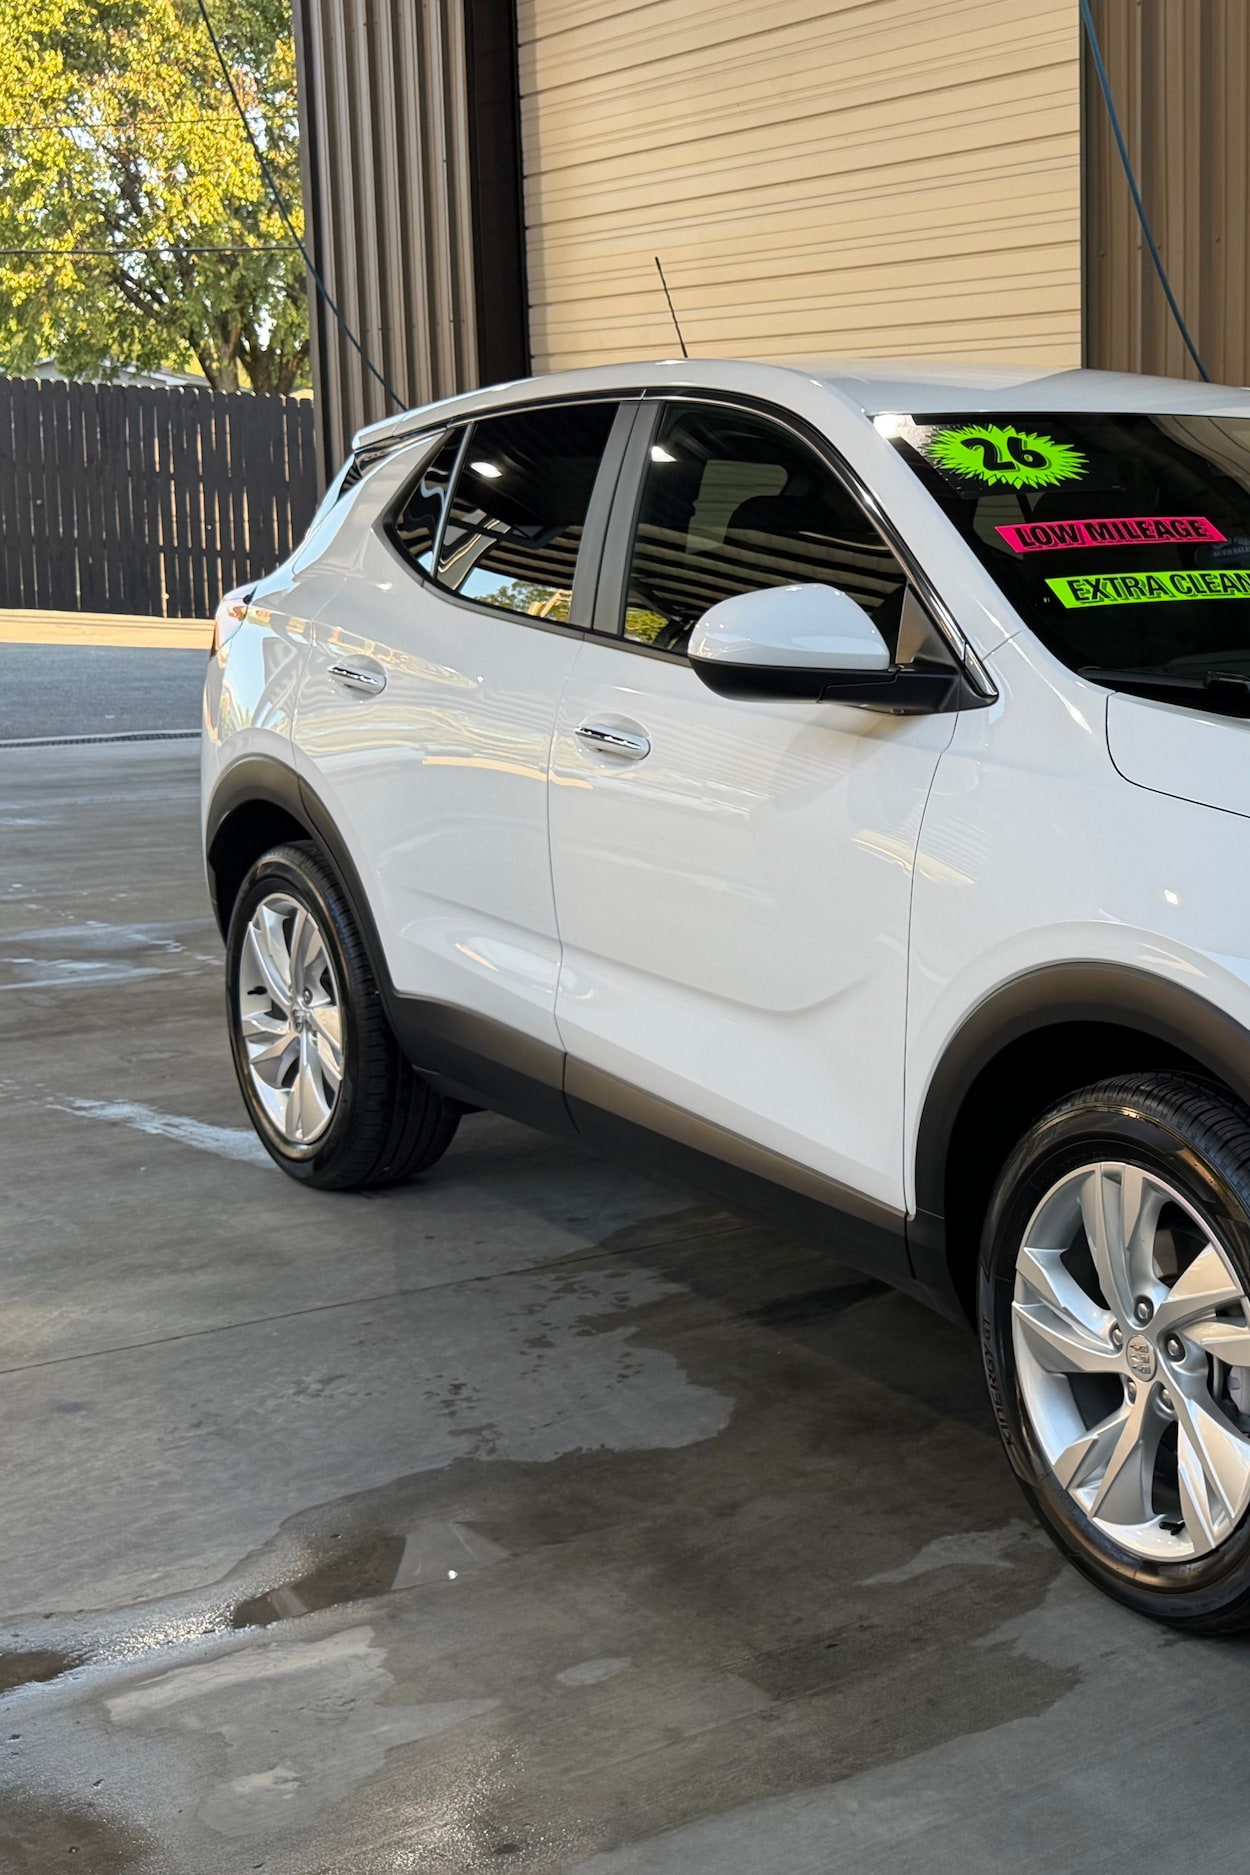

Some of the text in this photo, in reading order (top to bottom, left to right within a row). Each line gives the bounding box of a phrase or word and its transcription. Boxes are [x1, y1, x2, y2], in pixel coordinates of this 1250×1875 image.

[961, 436, 1049, 472] 26
[1013, 523, 1083, 549] LOW
[1087, 519, 1209, 544] MILEAGE
[1067, 574, 1170, 602] EXTRA
